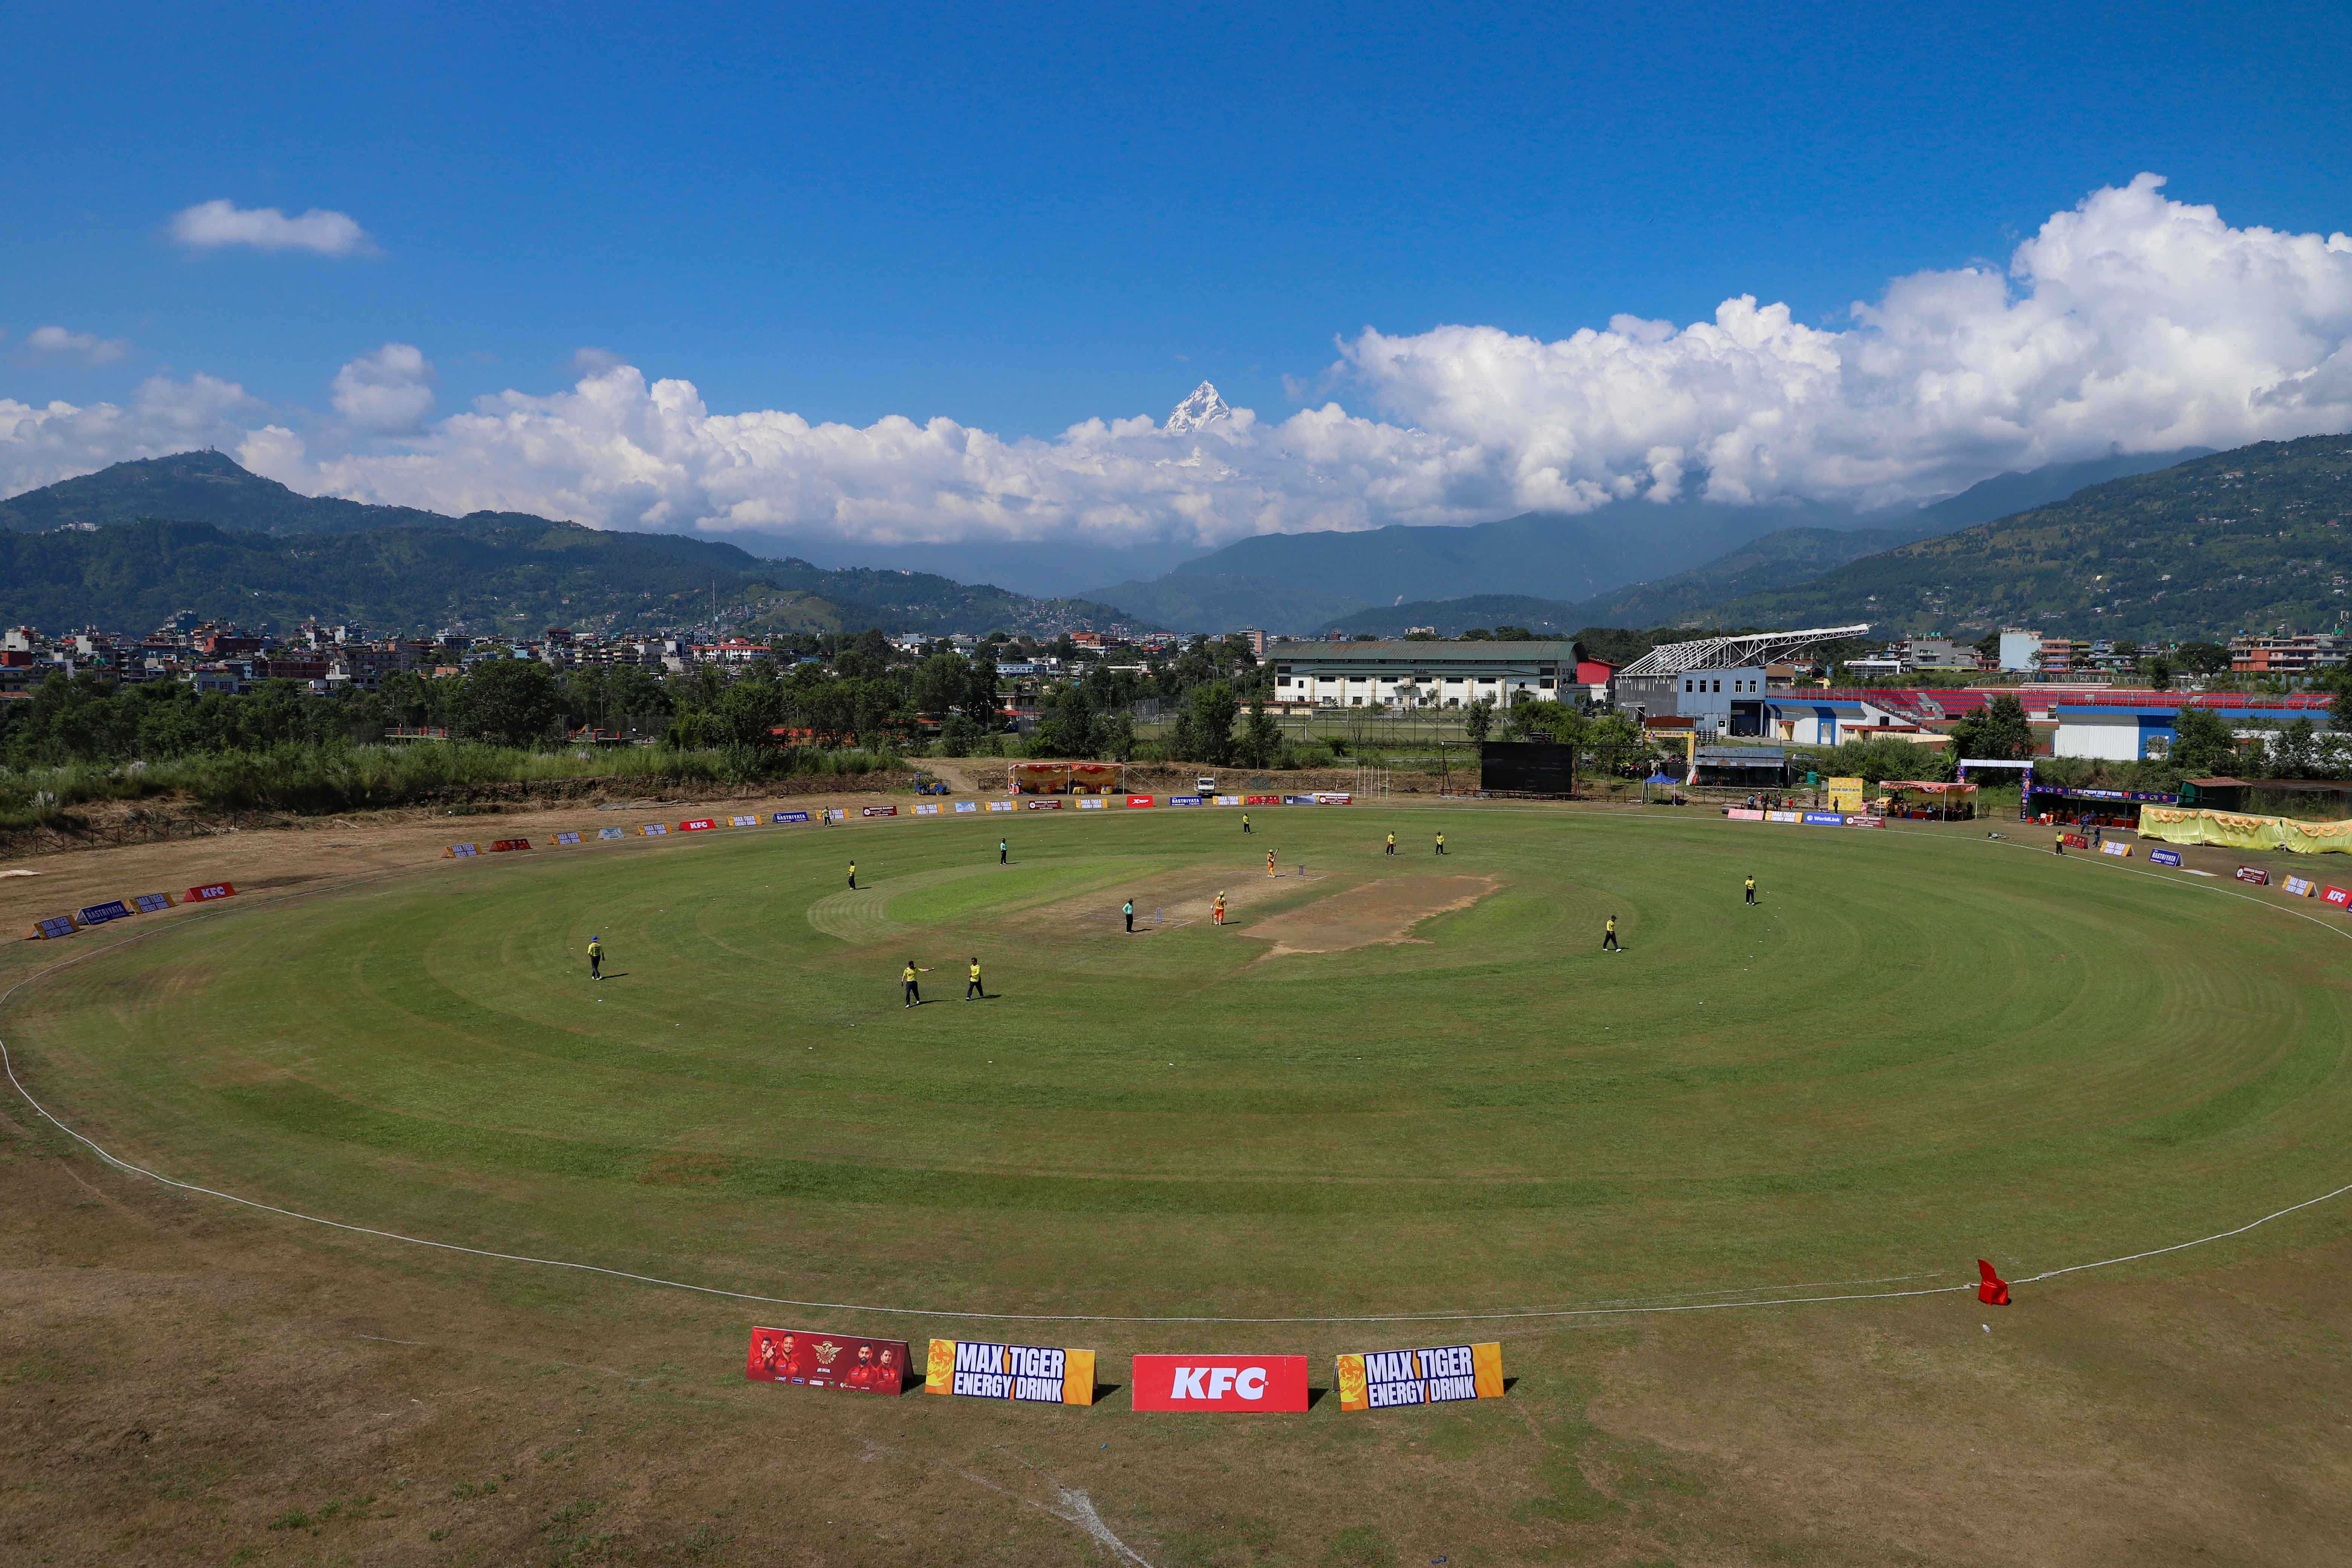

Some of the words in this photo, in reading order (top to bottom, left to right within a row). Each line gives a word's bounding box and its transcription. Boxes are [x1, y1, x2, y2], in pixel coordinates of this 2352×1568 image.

[2152, 852, 2176, 862] RASTRIYATA
[201, 886, 225, 899] KFC
[2327, 890, 2346, 903] KFC
[136, 896, 151, 906] MAX
[149, 894, 165, 904] TIGER
[86, 905, 123, 919] RASTRIYATA
[816, 1353, 836, 1364] AVENGERS
[956, 1343, 1003, 1374] MAX
[1009, 1347, 1064, 1378] TIGER
[1366, 1352, 1414, 1383] MAX
[1417, 1347, 1473, 1378] TIGER
[954, 1372, 1012, 1398] ENERGY
[1016, 1377, 1063, 1401] DRINK
[1170, 1367, 1266, 1400] KFC
[1368, 1380, 1426, 1407] ENERGY
[1429, 1375, 1476, 1401] DRINK
